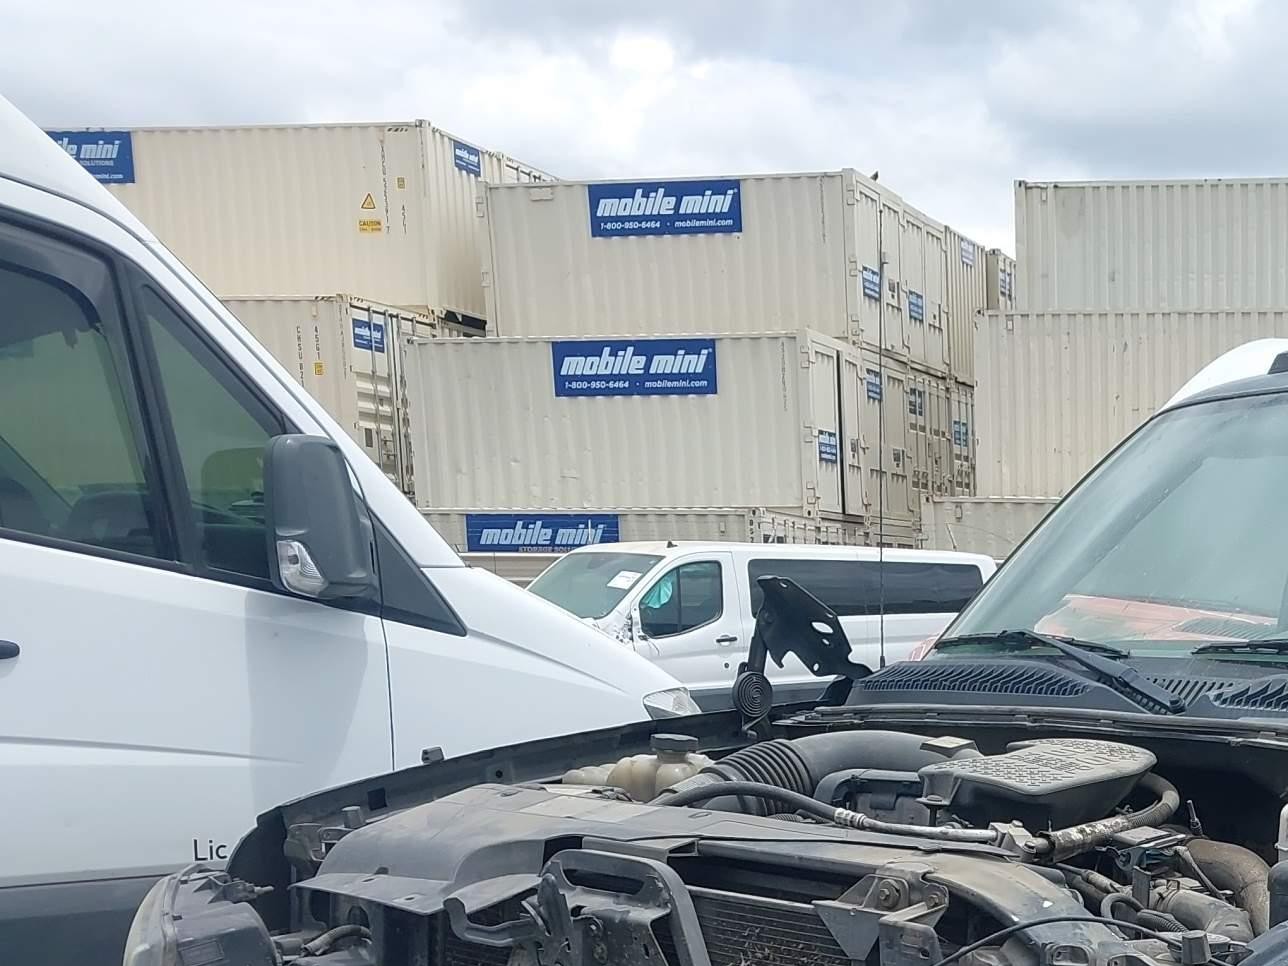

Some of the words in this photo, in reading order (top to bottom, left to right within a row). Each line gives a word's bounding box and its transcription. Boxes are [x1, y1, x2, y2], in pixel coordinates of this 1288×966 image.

[80, 140, 120, 158] mini
[596, 188, 676, 217] mobile
[678, 190, 734, 214] mini
[600, 220, 661, 230] 1-800-950-6464
[674, 218, 733, 228] mobilemini.com
[560, 346, 647, 375] mobile
[649, 350, 708, 374] mini
[565, 381, 629, 389] 1-800-950-6464
[644, 379, 708, 388] mobilemini.com
[480, 521, 552, 545] mobile
[555, 524, 604, 545] mini
